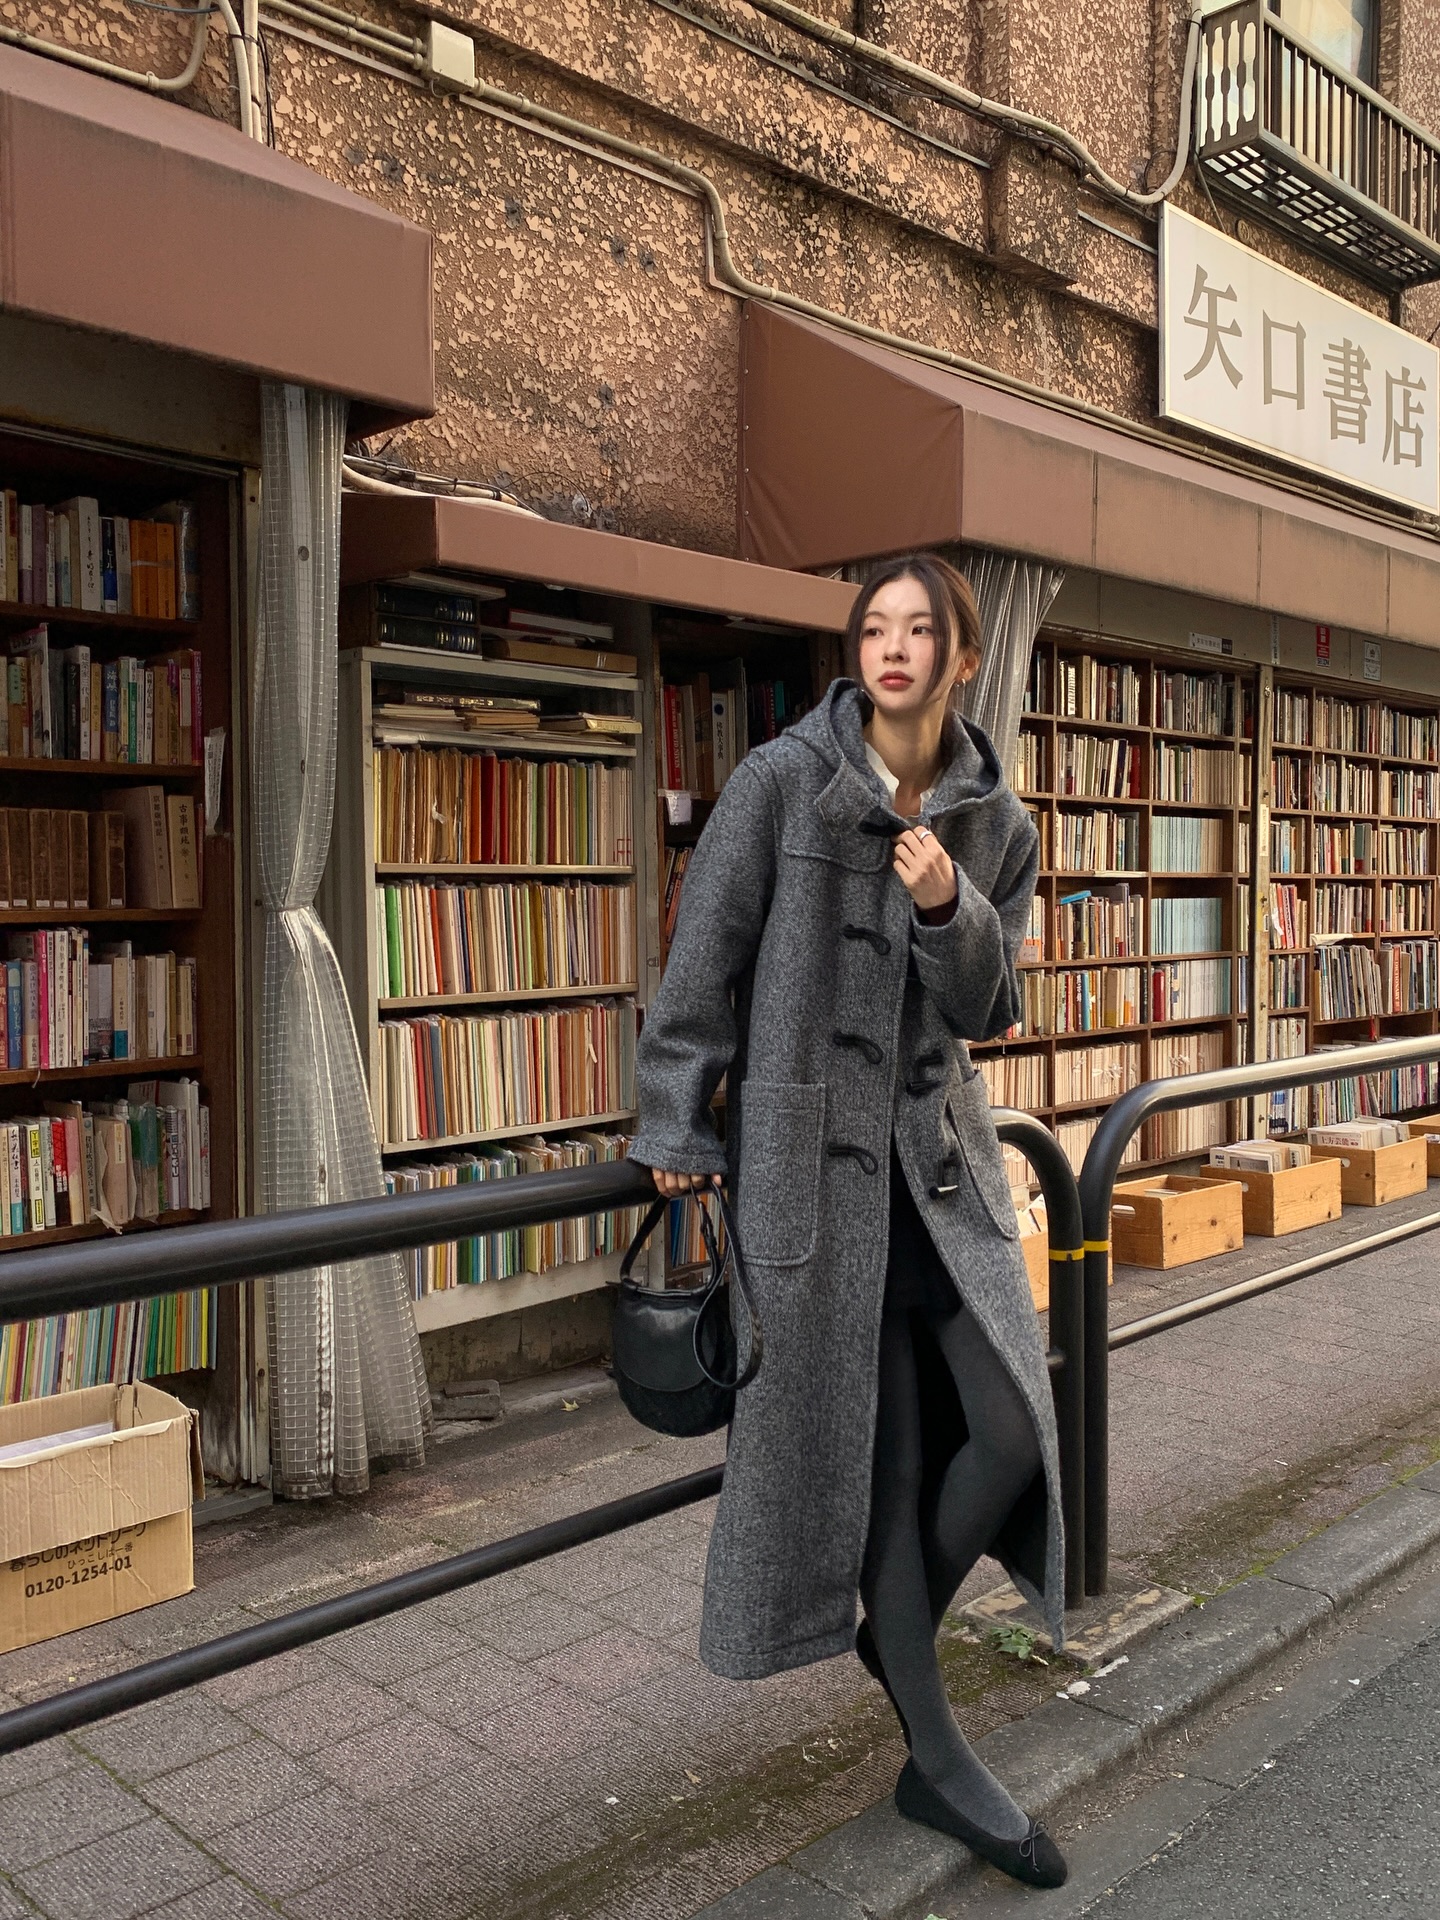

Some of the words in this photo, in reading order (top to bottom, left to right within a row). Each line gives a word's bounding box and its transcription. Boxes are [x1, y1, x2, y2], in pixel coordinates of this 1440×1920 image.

[1183, 264, 1427, 469] 矢口書店
[25, 1555, 133, 1598] 0120-1254-01
